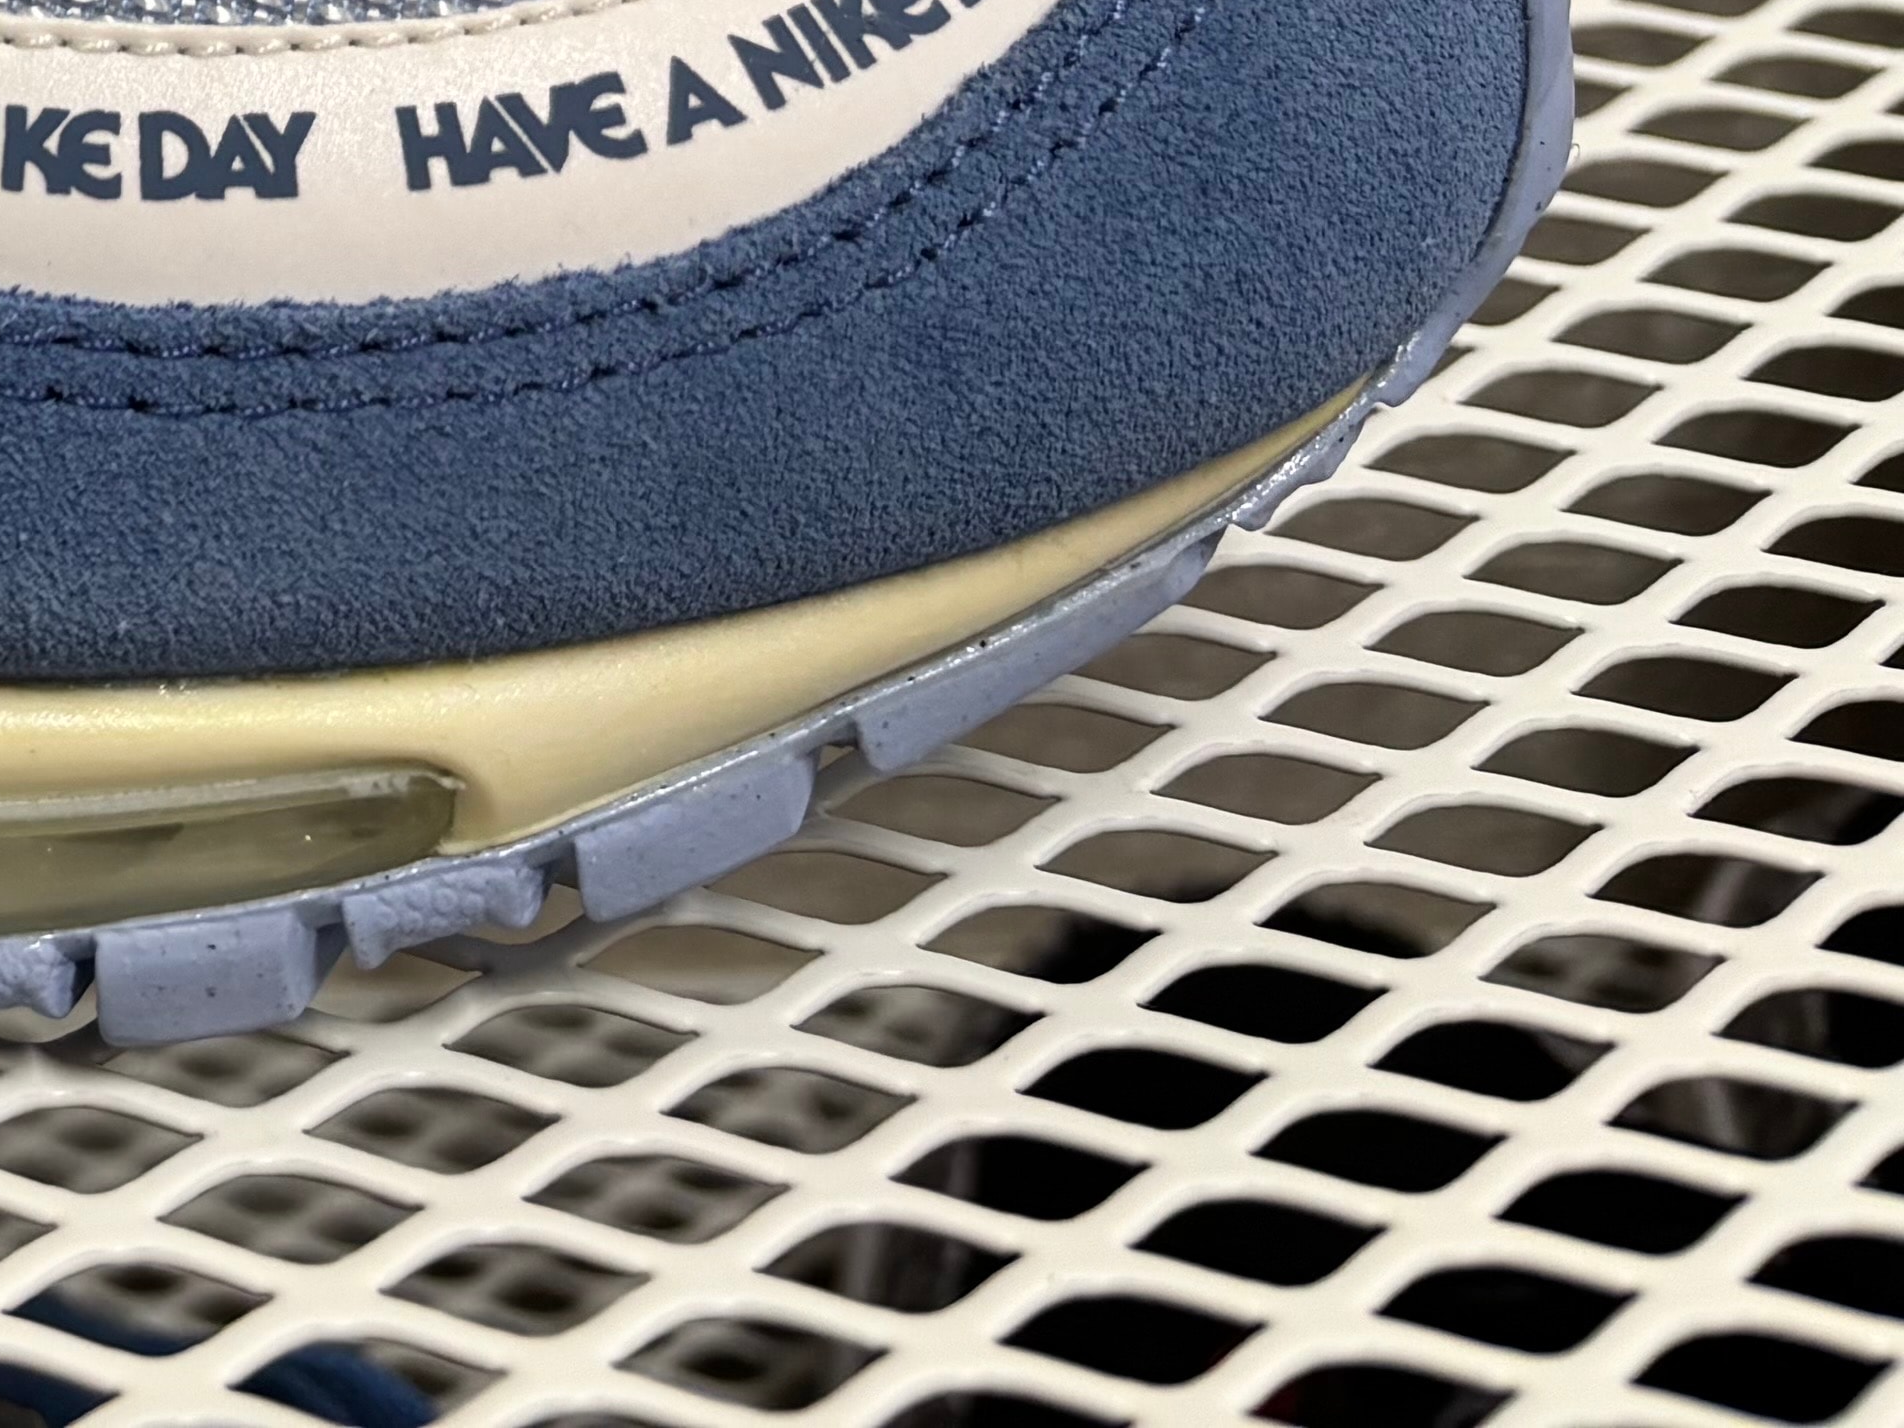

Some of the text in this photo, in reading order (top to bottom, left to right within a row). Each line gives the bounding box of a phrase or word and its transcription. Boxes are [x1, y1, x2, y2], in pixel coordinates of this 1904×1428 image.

[137, 108, 317, 202] DAY
[394, 71, 648, 191] HAVE
[665, 54, 748, 146] A
